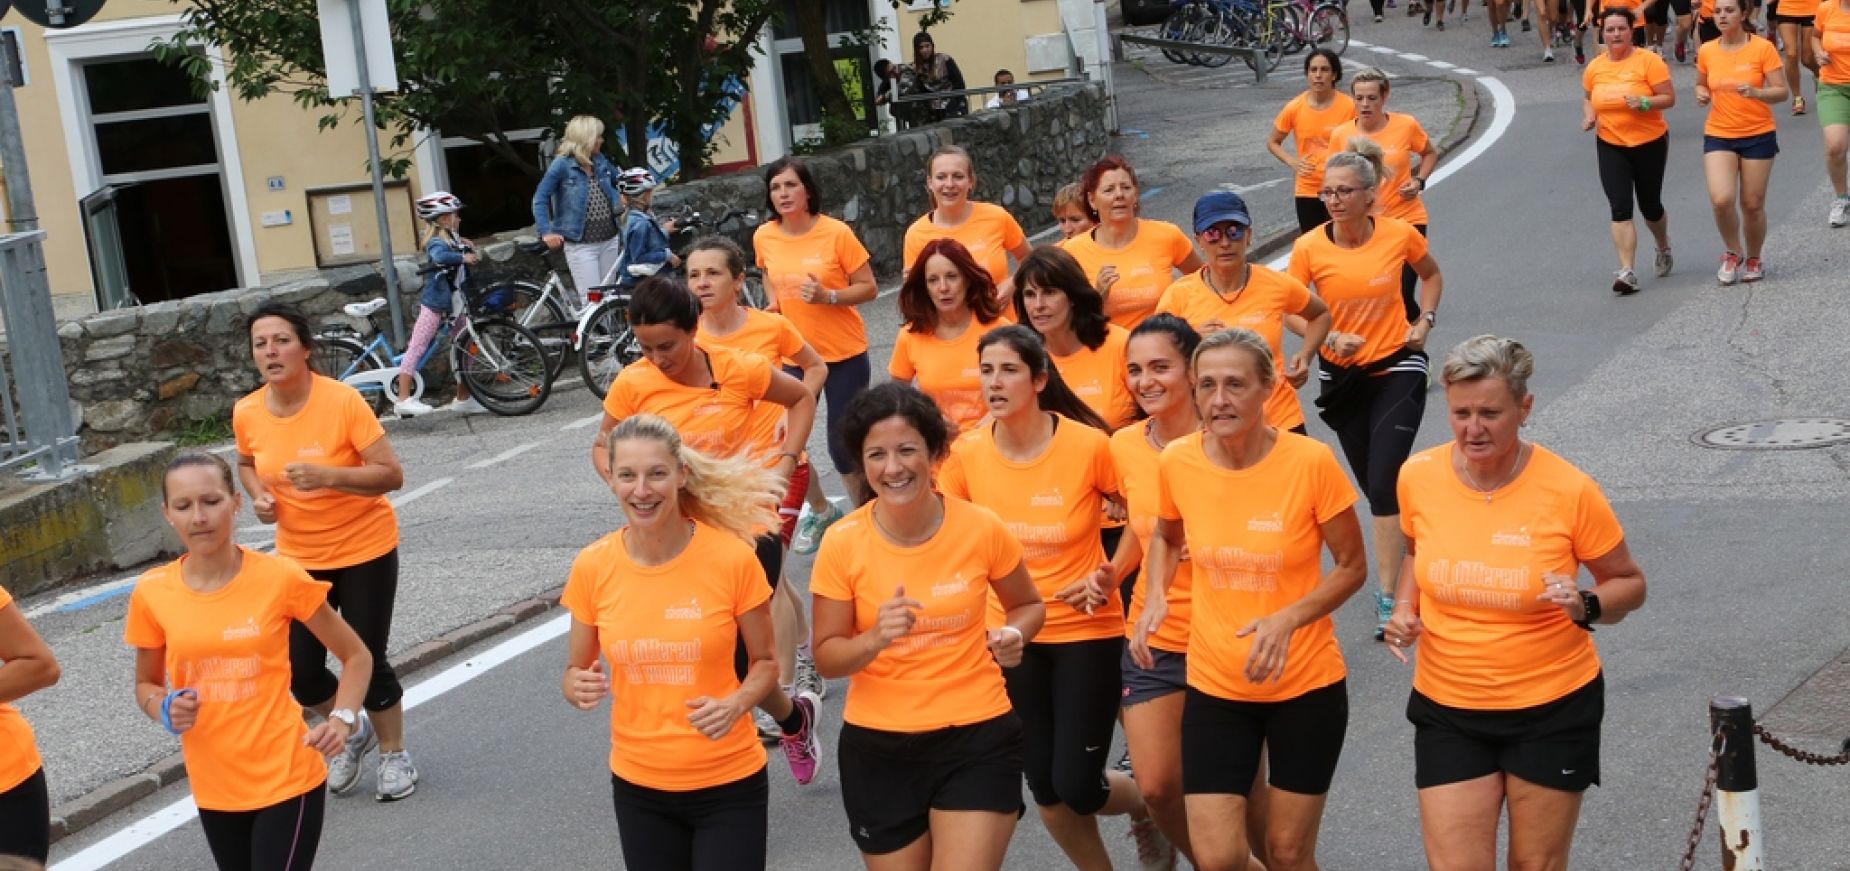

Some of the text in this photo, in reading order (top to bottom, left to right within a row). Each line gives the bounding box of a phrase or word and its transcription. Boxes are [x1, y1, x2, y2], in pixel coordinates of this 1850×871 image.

[1215, 547, 1283, 572] different
[1428, 559, 1530, 590] all different
[1459, 588, 1521, 610] women
[631, 638, 701, 662] different
[644, 664, 695, 685] women
